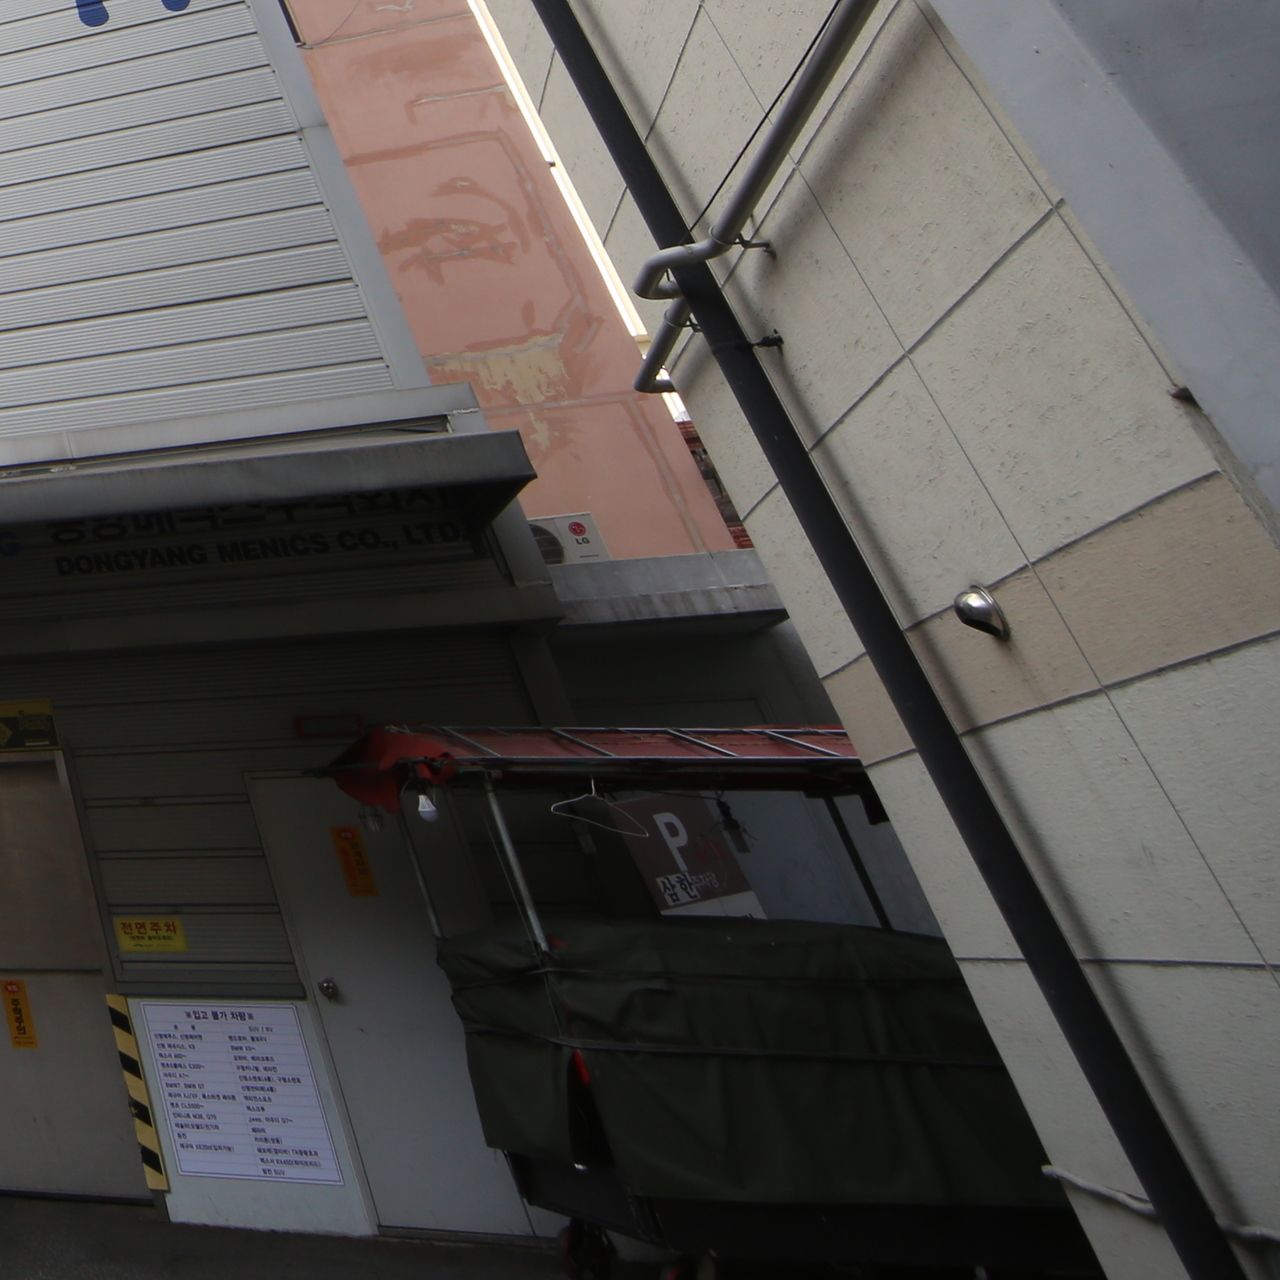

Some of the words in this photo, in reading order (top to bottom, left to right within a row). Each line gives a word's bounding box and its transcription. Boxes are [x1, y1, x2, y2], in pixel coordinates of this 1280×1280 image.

[55, 543, 209, 577] DONGYANG
[216, 532, 330, 563] MENICS
[576, 536, 591, 545] LG
[652, 812, 689, 872] P
